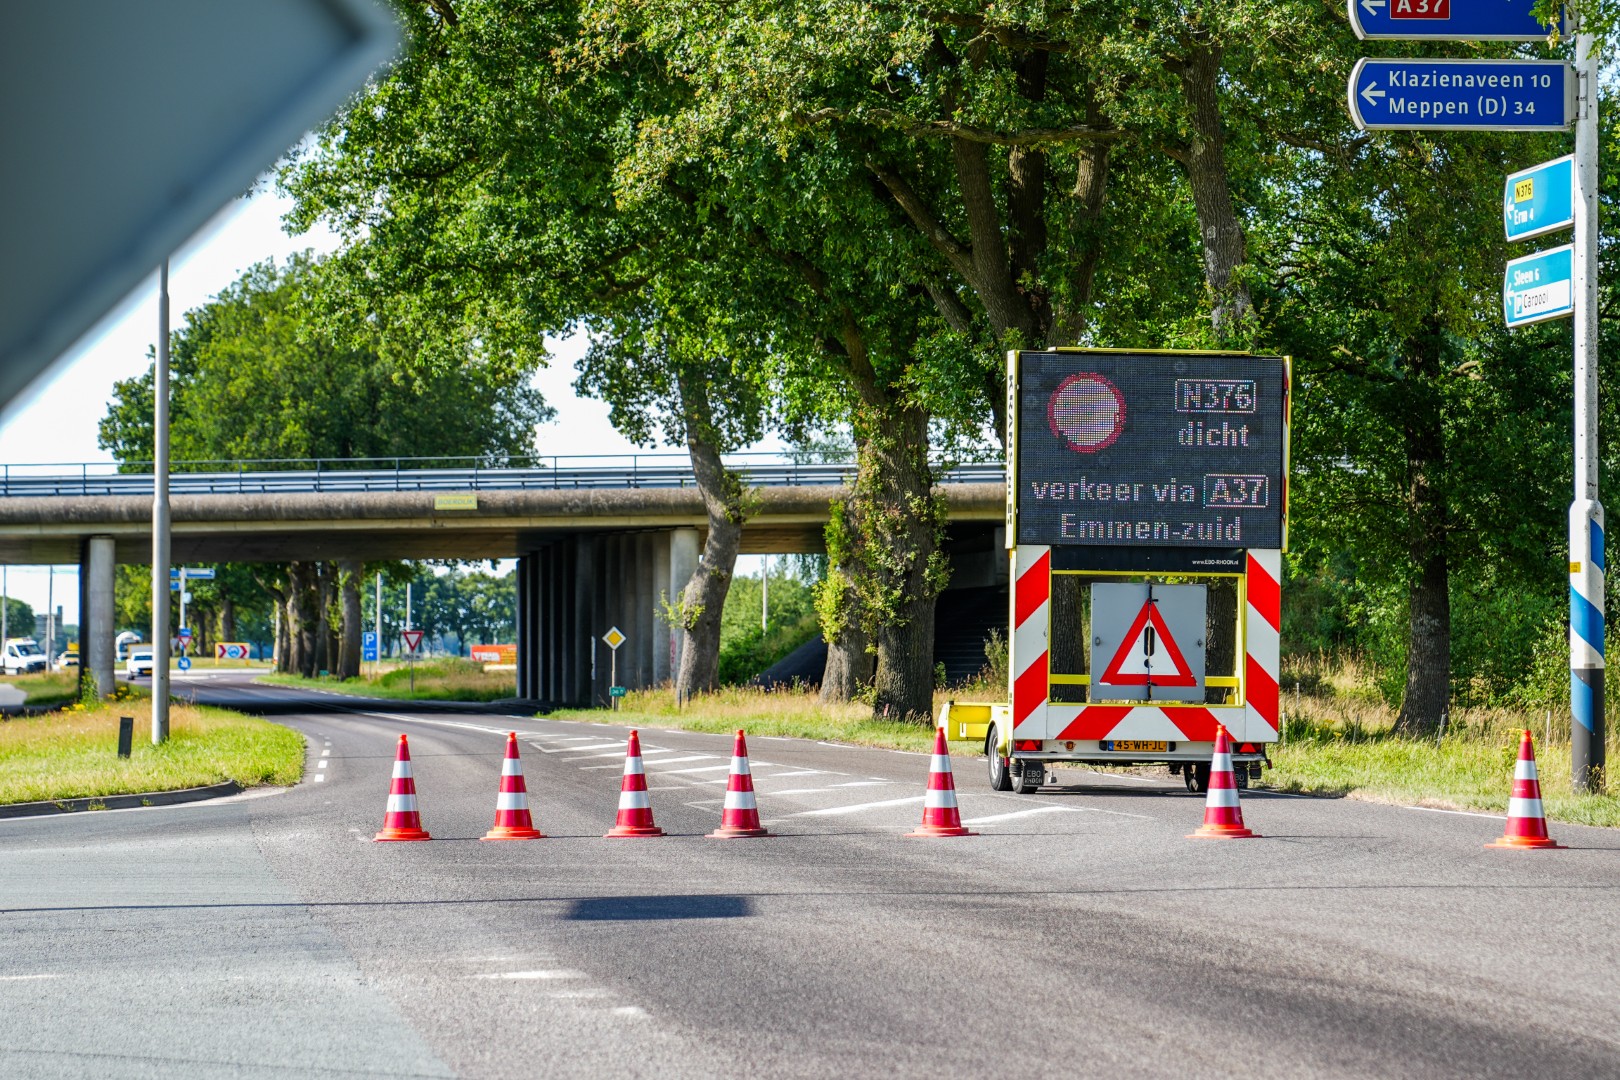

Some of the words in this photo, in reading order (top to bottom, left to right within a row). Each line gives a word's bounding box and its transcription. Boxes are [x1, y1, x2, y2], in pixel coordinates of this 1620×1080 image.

[1389, 70, 1523, 88] Klazienaveen
[1530, 74, 1551, 88] 10
[1389, 97, 1469, 118] Meppen
[1477, 96, 1507, 117] (D)
[1513, 101, 1536, 115] 34
[1515, 183, 1532, 199] N376
[1514, 209, 1528, 225] Erm
[1514, 269, 1533, 286] Sleen
[1535, 268, 1540, 281] 6
[1523, 290, 1549, 309] Carpool
[1183, 383, 1252, 409] N376
[1178, 421, 1249, 447] dicht
[1031, 475, 1144, 501] verkeer
[1152, 477, 1195, 502] via
[1210, 478, 1263, 504] A37
[1060, 512, 1241, 541] Emmen-zuid
[1116, 740, 1164, 750] 45-WH-JL
[1026, 770, 1041, 778] EBO
